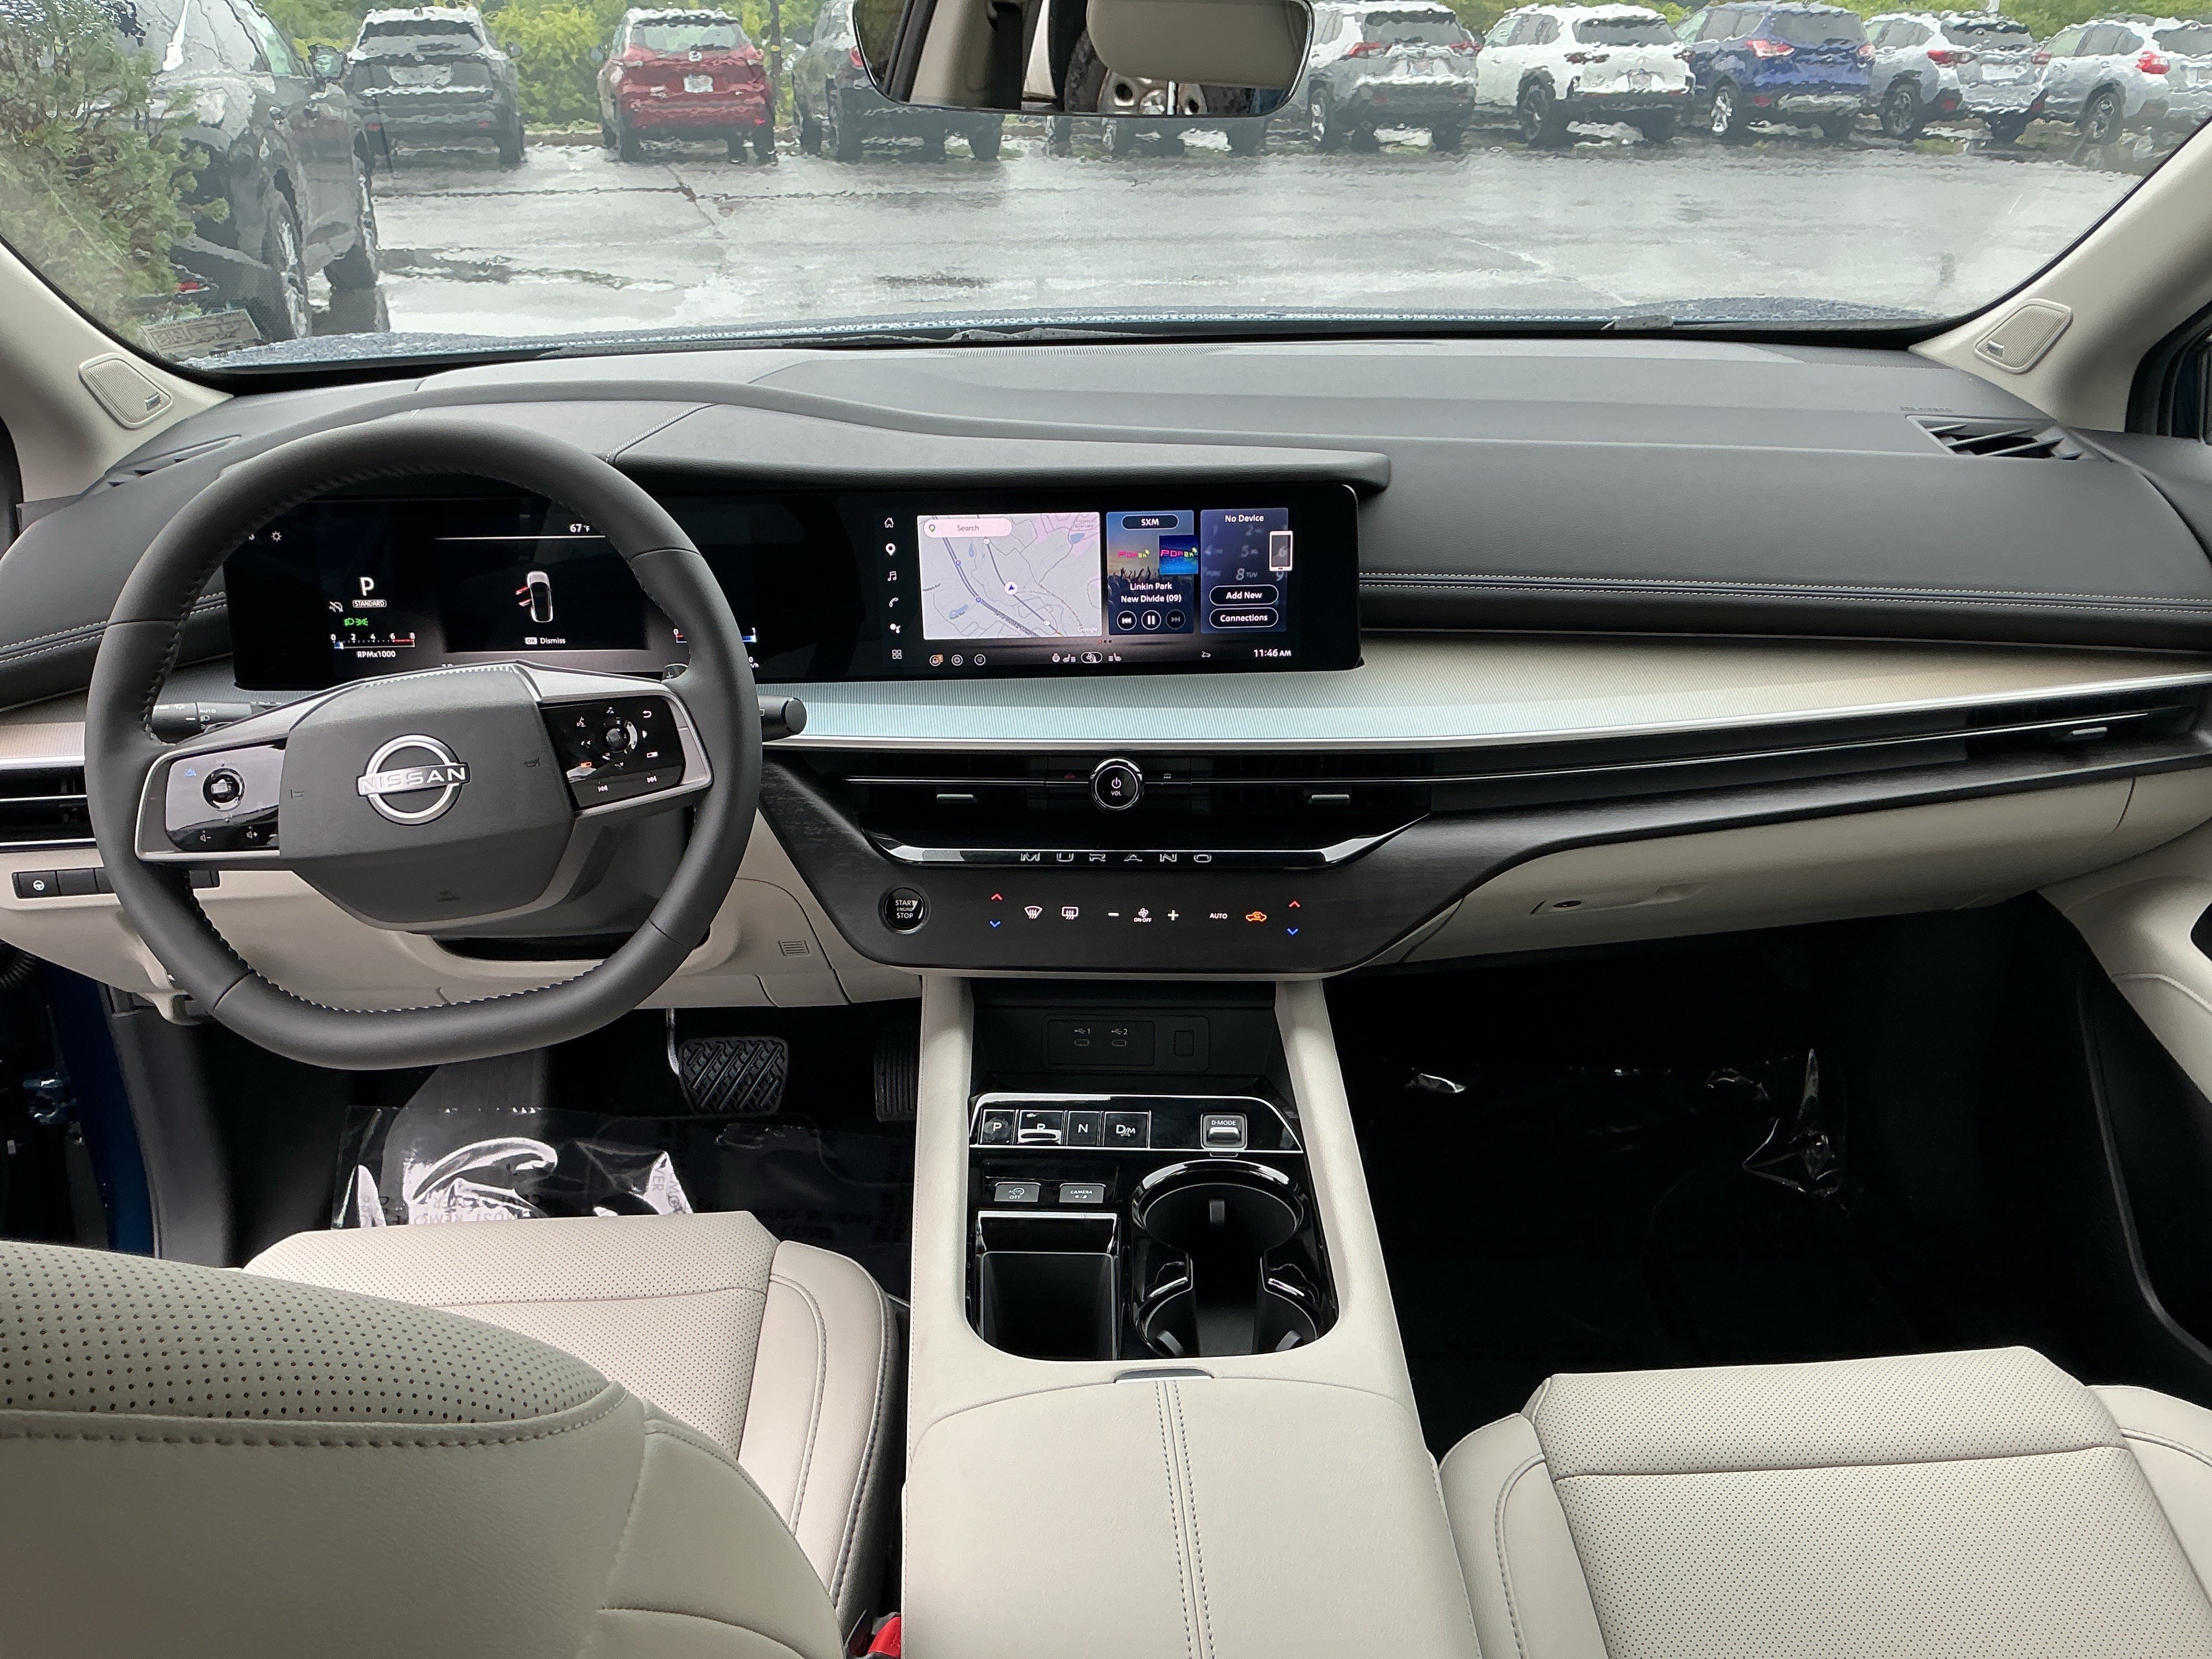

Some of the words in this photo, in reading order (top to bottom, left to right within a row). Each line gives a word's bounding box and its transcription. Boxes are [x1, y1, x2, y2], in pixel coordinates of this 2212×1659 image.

[1236, 568, 1245, 581] 8
[360, 577, 374, 596] P
[1130, 583, 1153, 591] Linkin
[1141, 594, 1165, 602] Divide
[1166, 594, 1182, 603] (09)
[1220, 614, 1268, 622] Connections
[1254, 649, 1278, 657] 11:46
[361, 767, 466, 793] NISSAN
[1020, 852, 1212, 862] MURANO
[992, 1122, 1002, 1132] P
[1077, 1124, 1088, 1133] N
